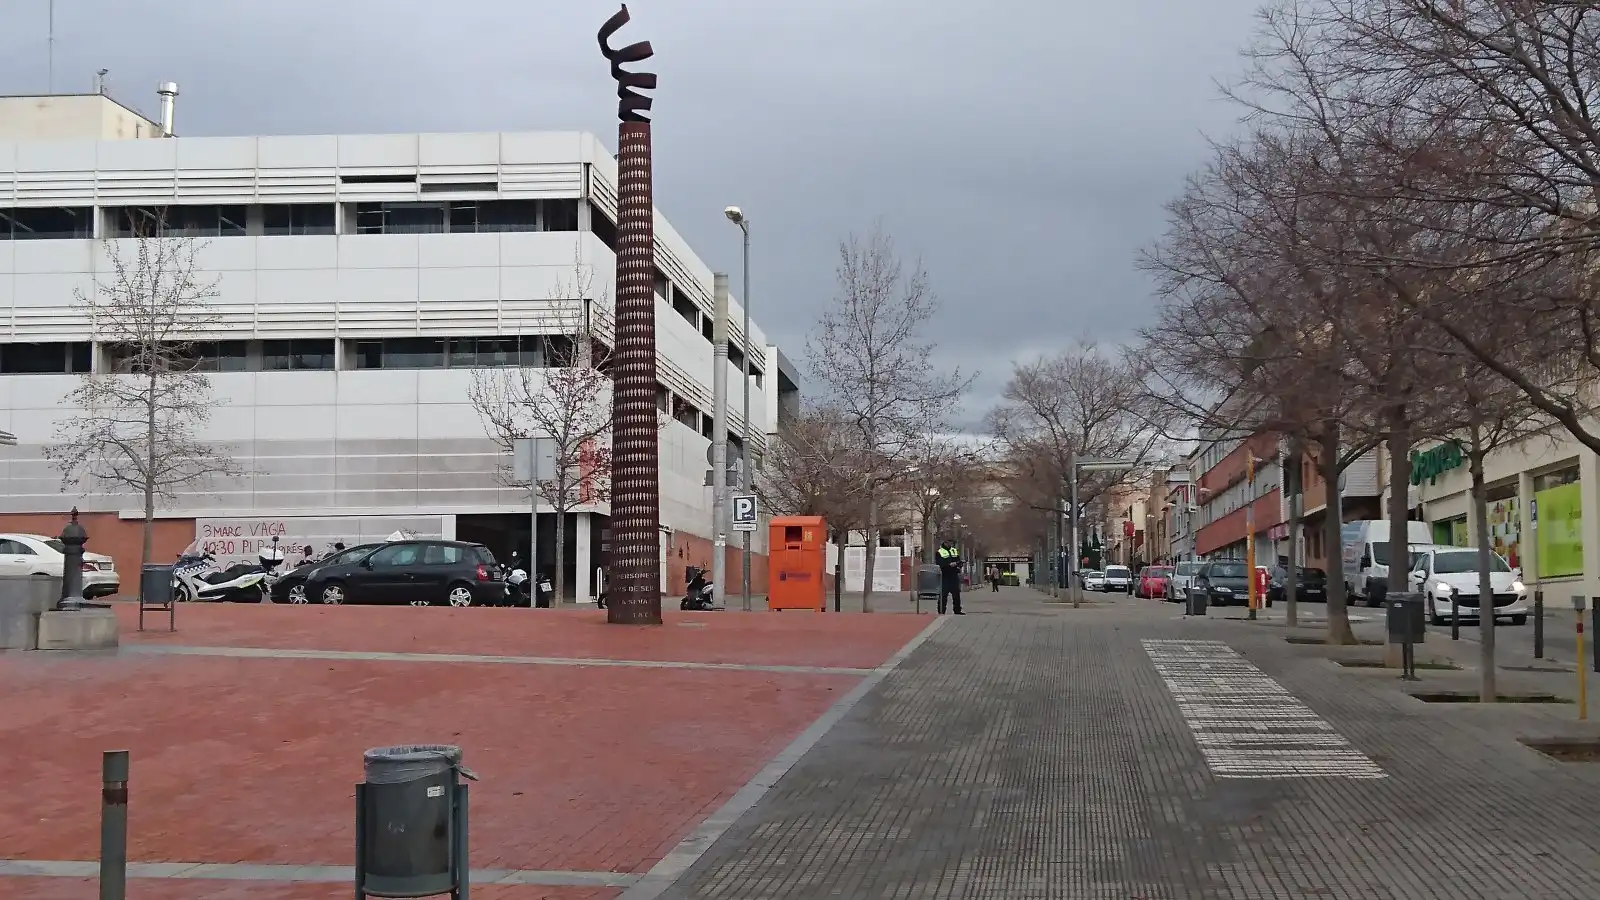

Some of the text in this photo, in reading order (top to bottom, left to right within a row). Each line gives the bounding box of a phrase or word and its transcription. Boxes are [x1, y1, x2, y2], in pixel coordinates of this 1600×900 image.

[736, 498, 752, 520] P
[203, 524, 212, 538] 3
[248, 522, 287, 537] VAGA
[202, 540, 235, 555] 10:30
